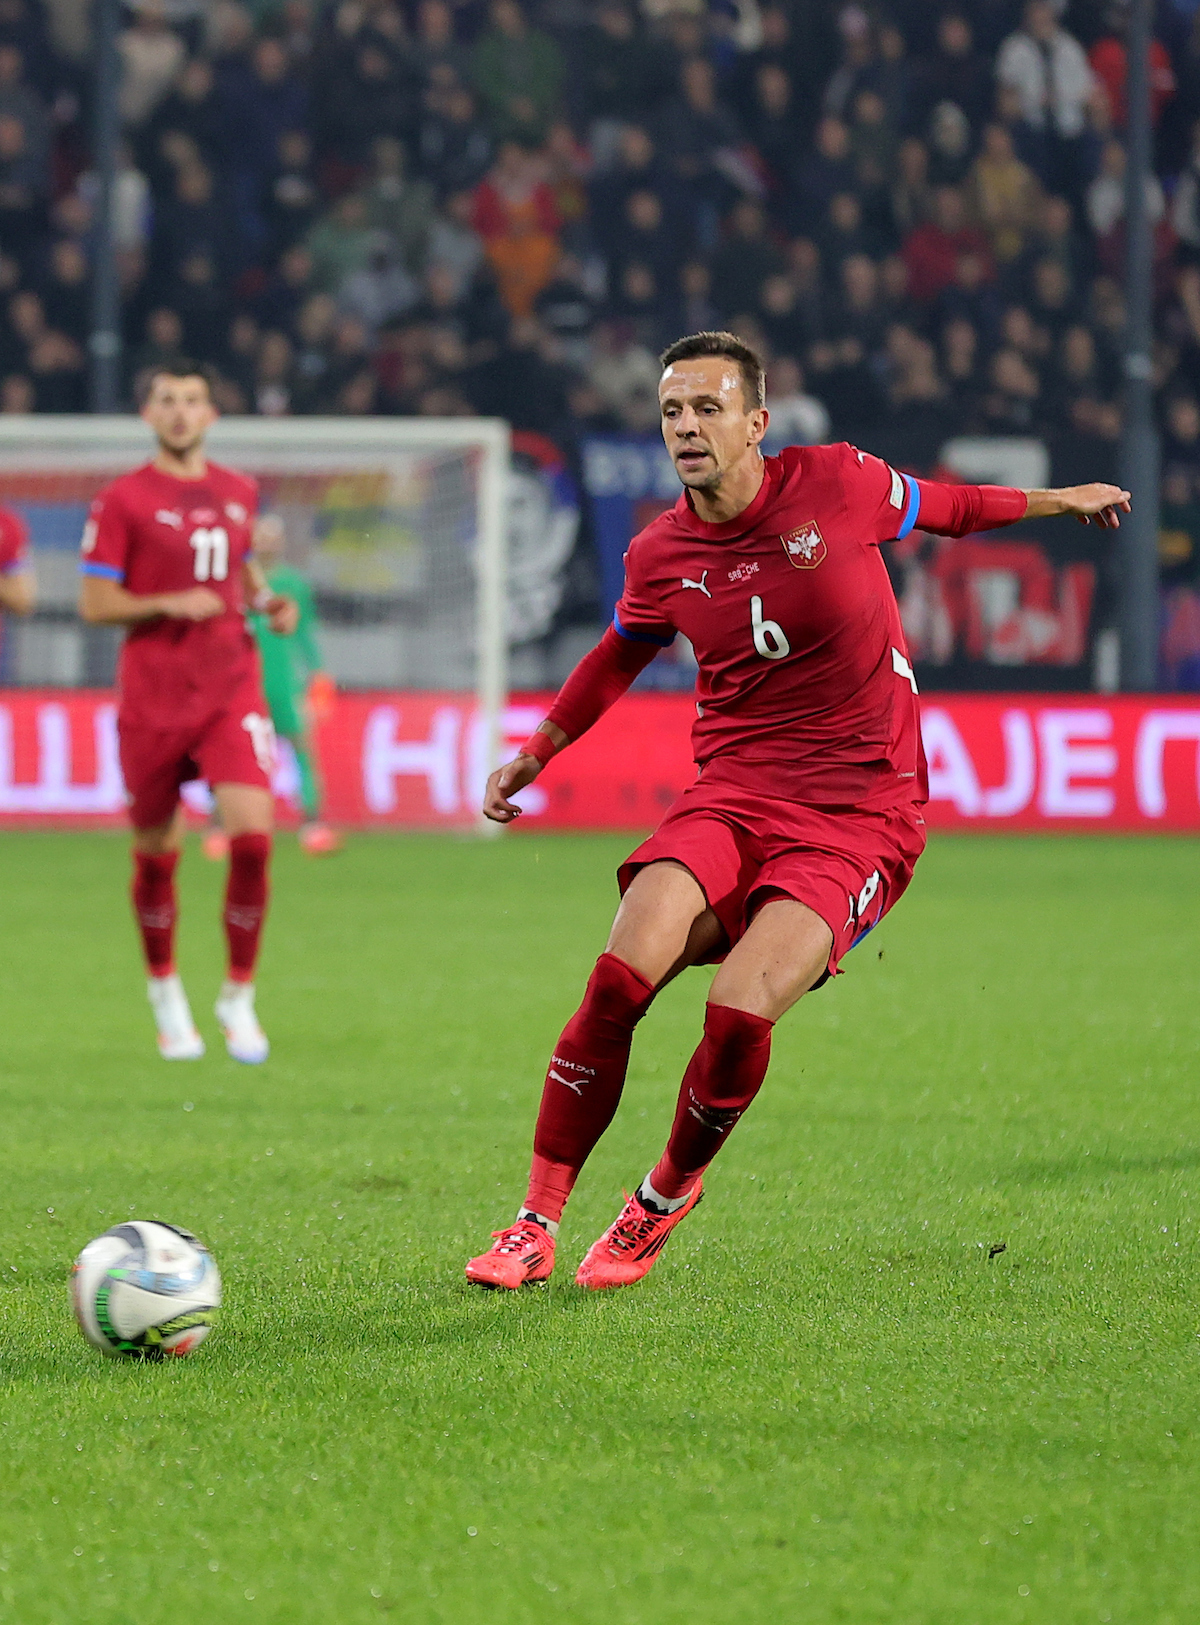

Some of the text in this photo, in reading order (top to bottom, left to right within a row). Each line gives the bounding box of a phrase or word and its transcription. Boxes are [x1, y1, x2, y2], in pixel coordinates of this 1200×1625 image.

[188, 525, 229, 583] 11
[750, 595, 791, 660] 6
[362, 705, 548, 816] НЕ
